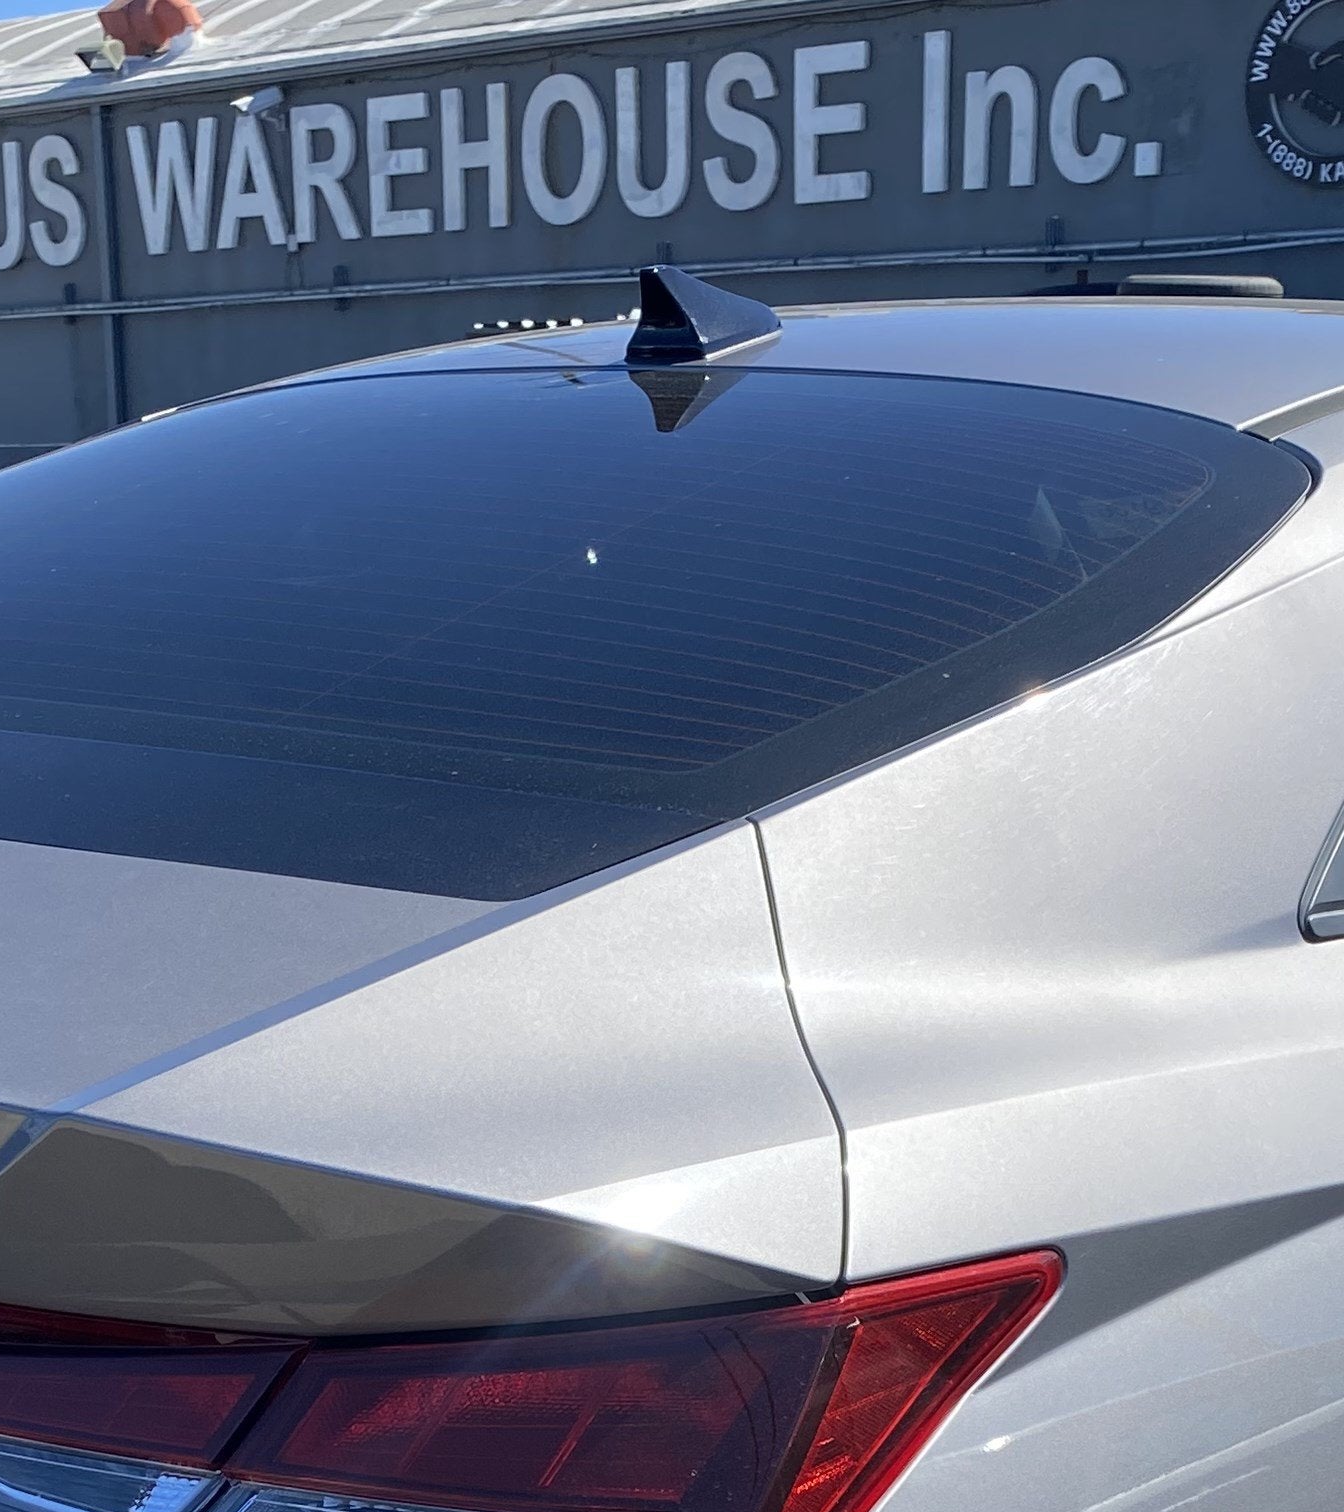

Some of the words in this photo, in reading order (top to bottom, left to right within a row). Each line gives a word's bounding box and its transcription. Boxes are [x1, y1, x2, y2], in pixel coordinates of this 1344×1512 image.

[126, 40, 872, 255] WAREHOUSE
[922, 29, 1163, 194] Inc.
[1257, 123, 1313, 179] 1-(888)
